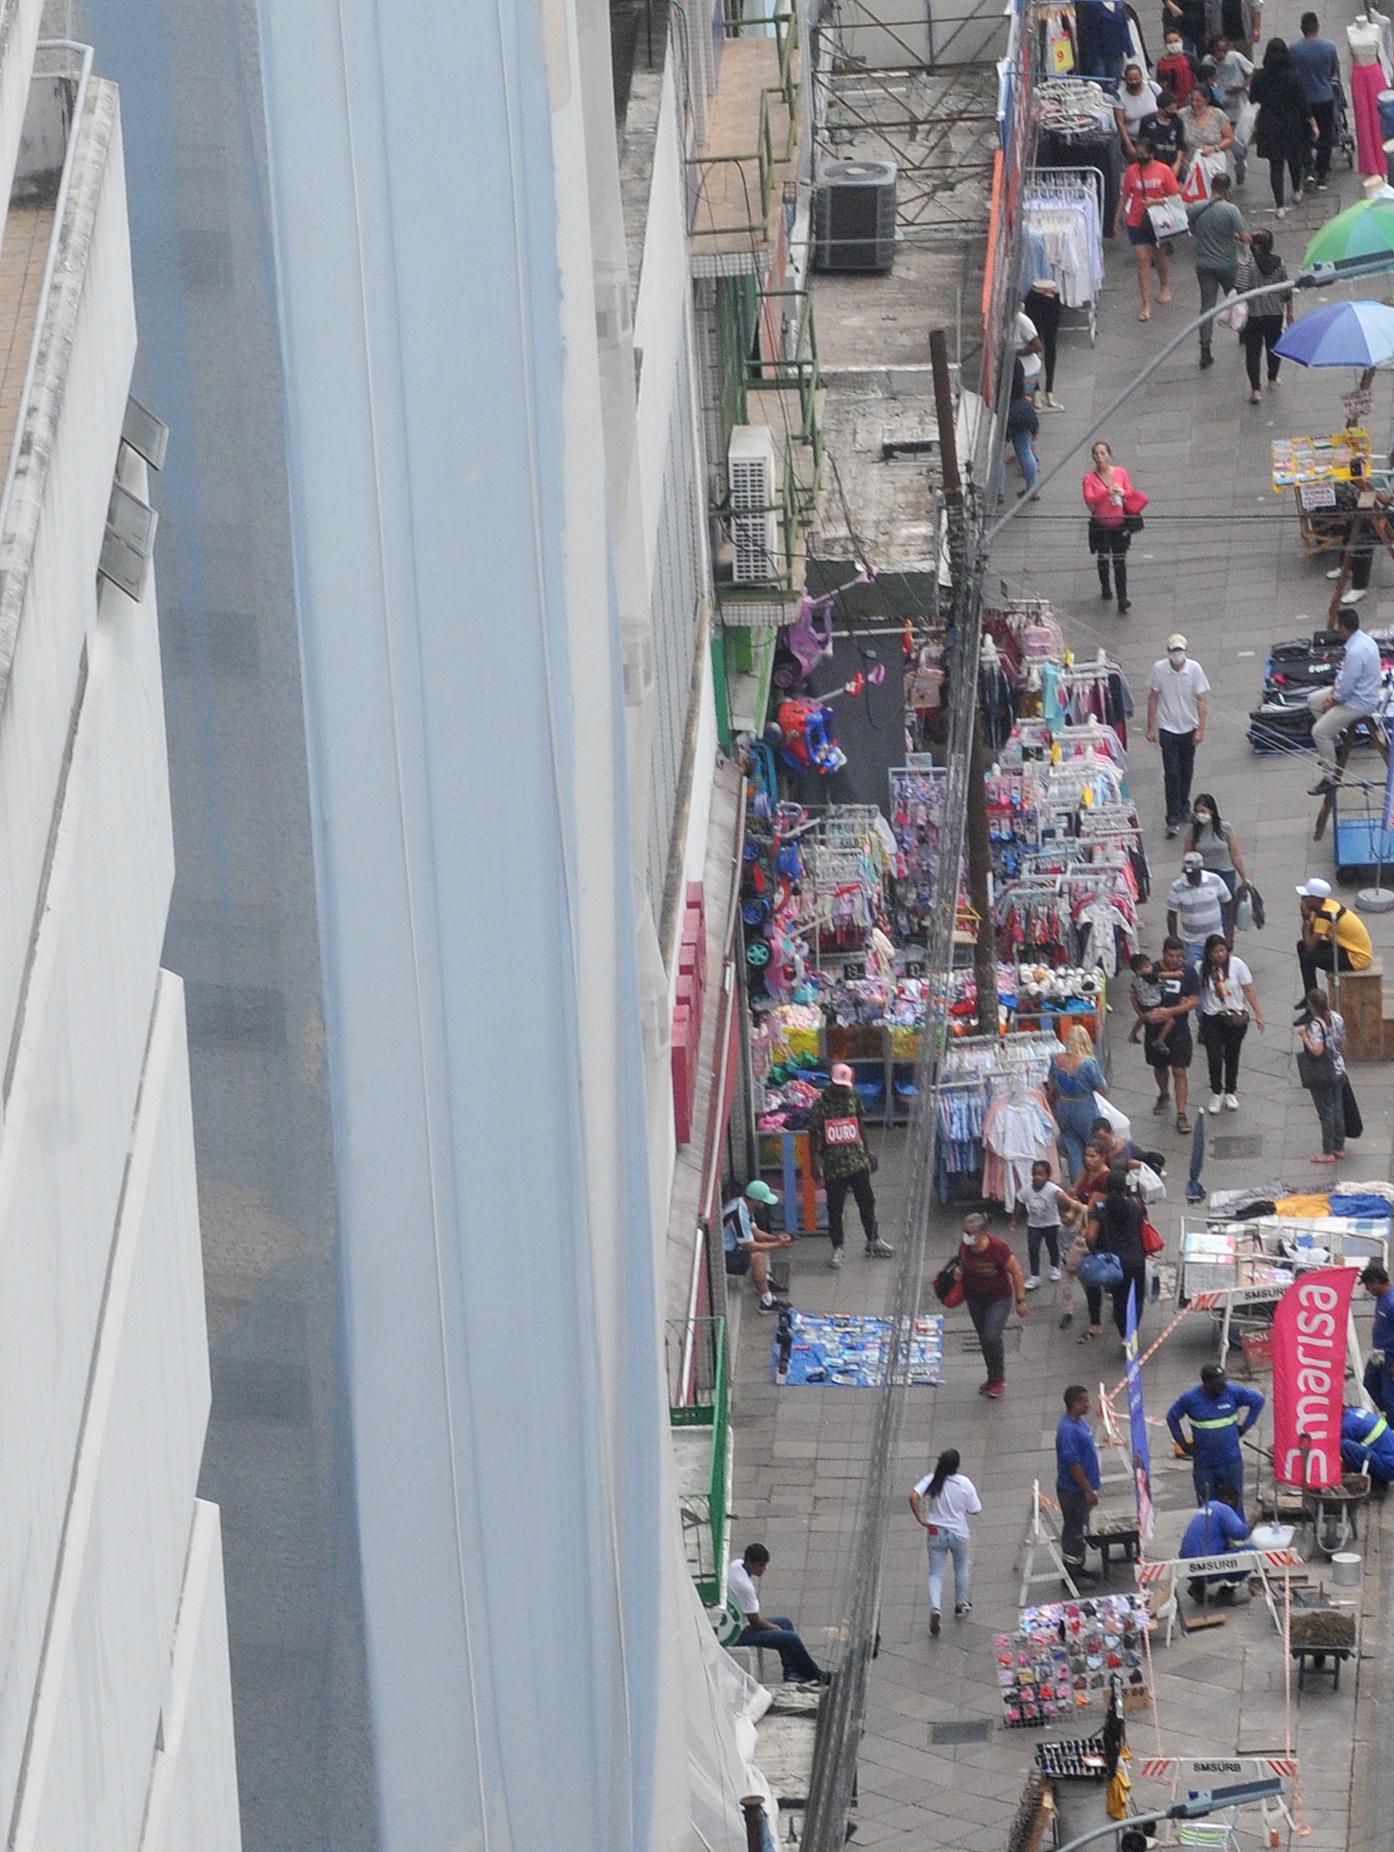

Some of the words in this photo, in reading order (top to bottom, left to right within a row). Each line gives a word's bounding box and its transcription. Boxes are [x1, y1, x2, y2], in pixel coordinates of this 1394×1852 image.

[827, 1124, 857, 1142] OURO
[1244, 1287, 1288, 1301] SMSUR
[1295, 1284, 1338, 1439] marisa
[1189, 1558, 1239, 1574] SMSURB
[1193, 1761, 1242, 1773] SMSURB
